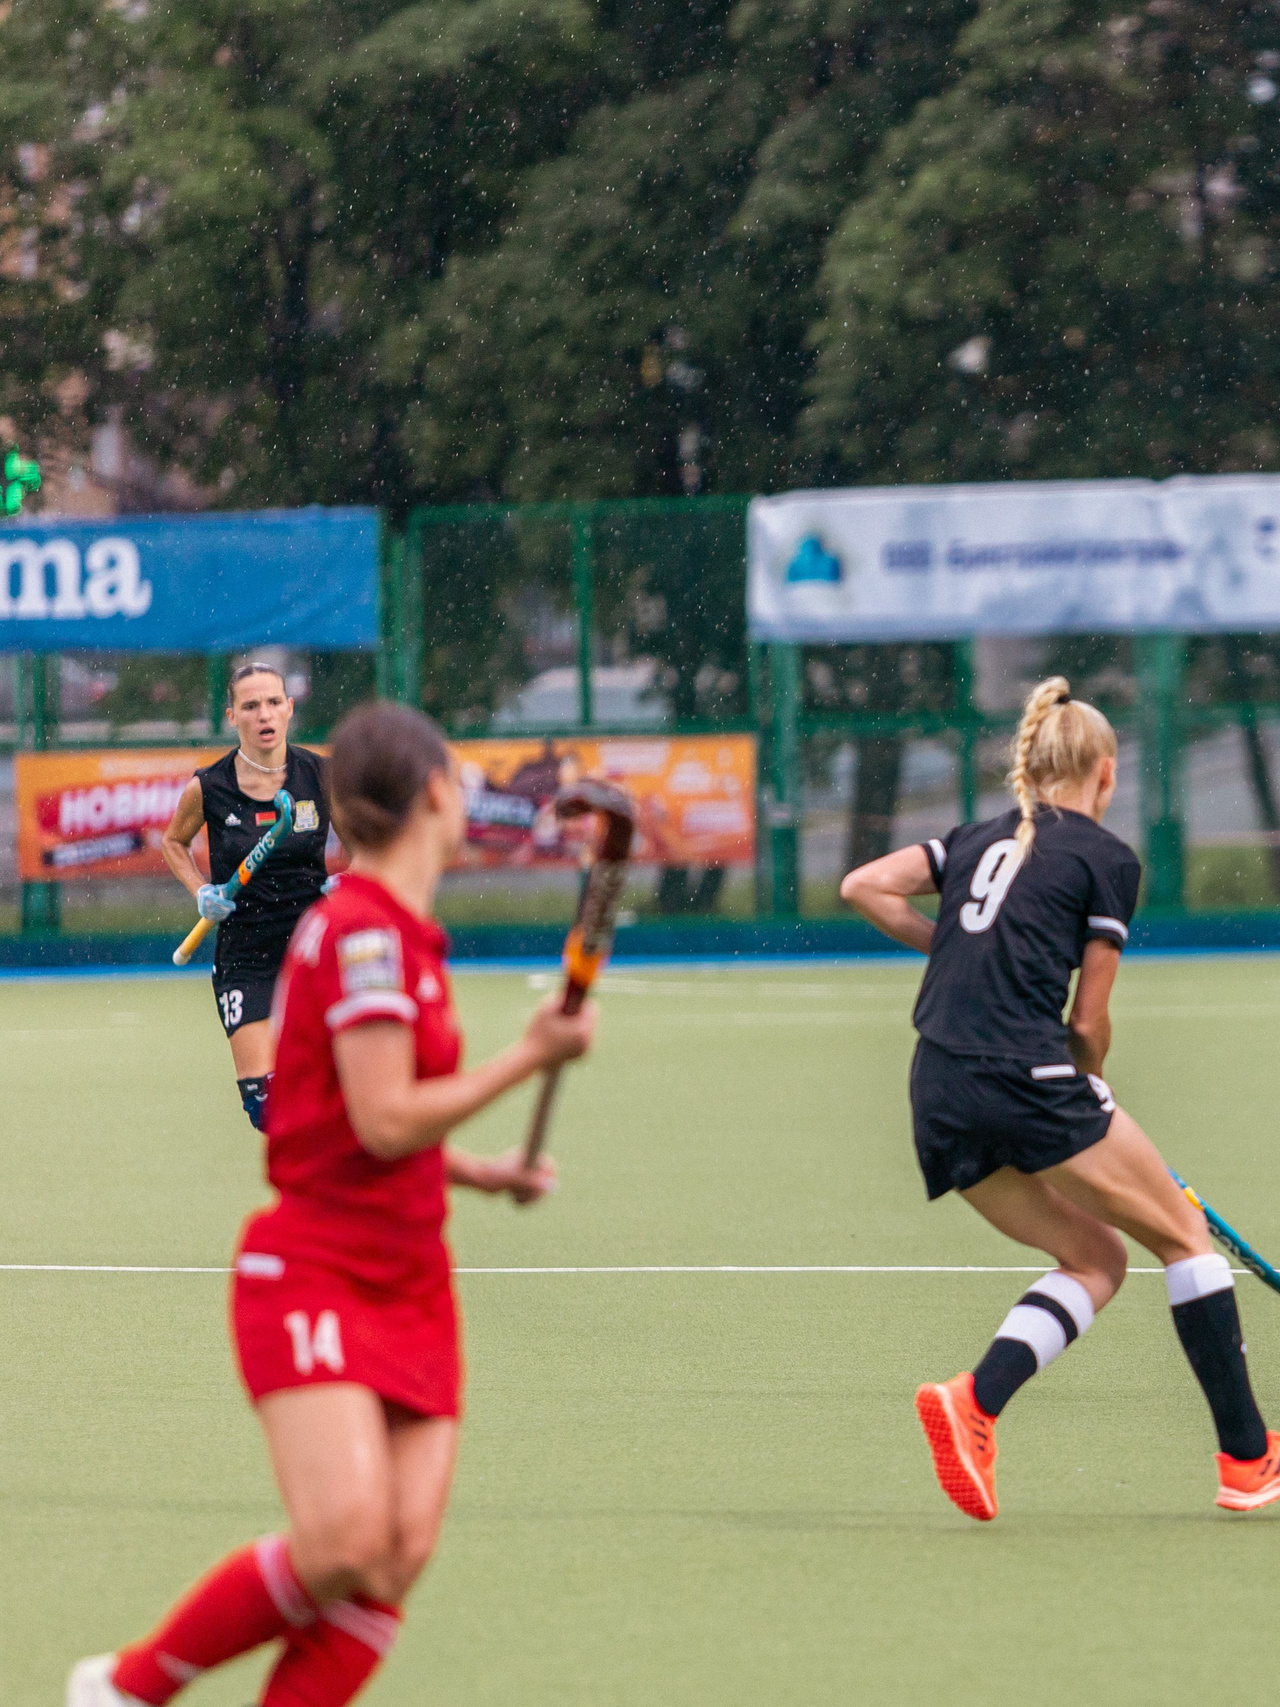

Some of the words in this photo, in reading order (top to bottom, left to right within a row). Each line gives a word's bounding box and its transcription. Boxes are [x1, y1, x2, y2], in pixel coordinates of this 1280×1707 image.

[959, 838, 1026, 934] 9
[219, 988, 244, 1029] 13
[283, 1309, 346, 1375] 14
